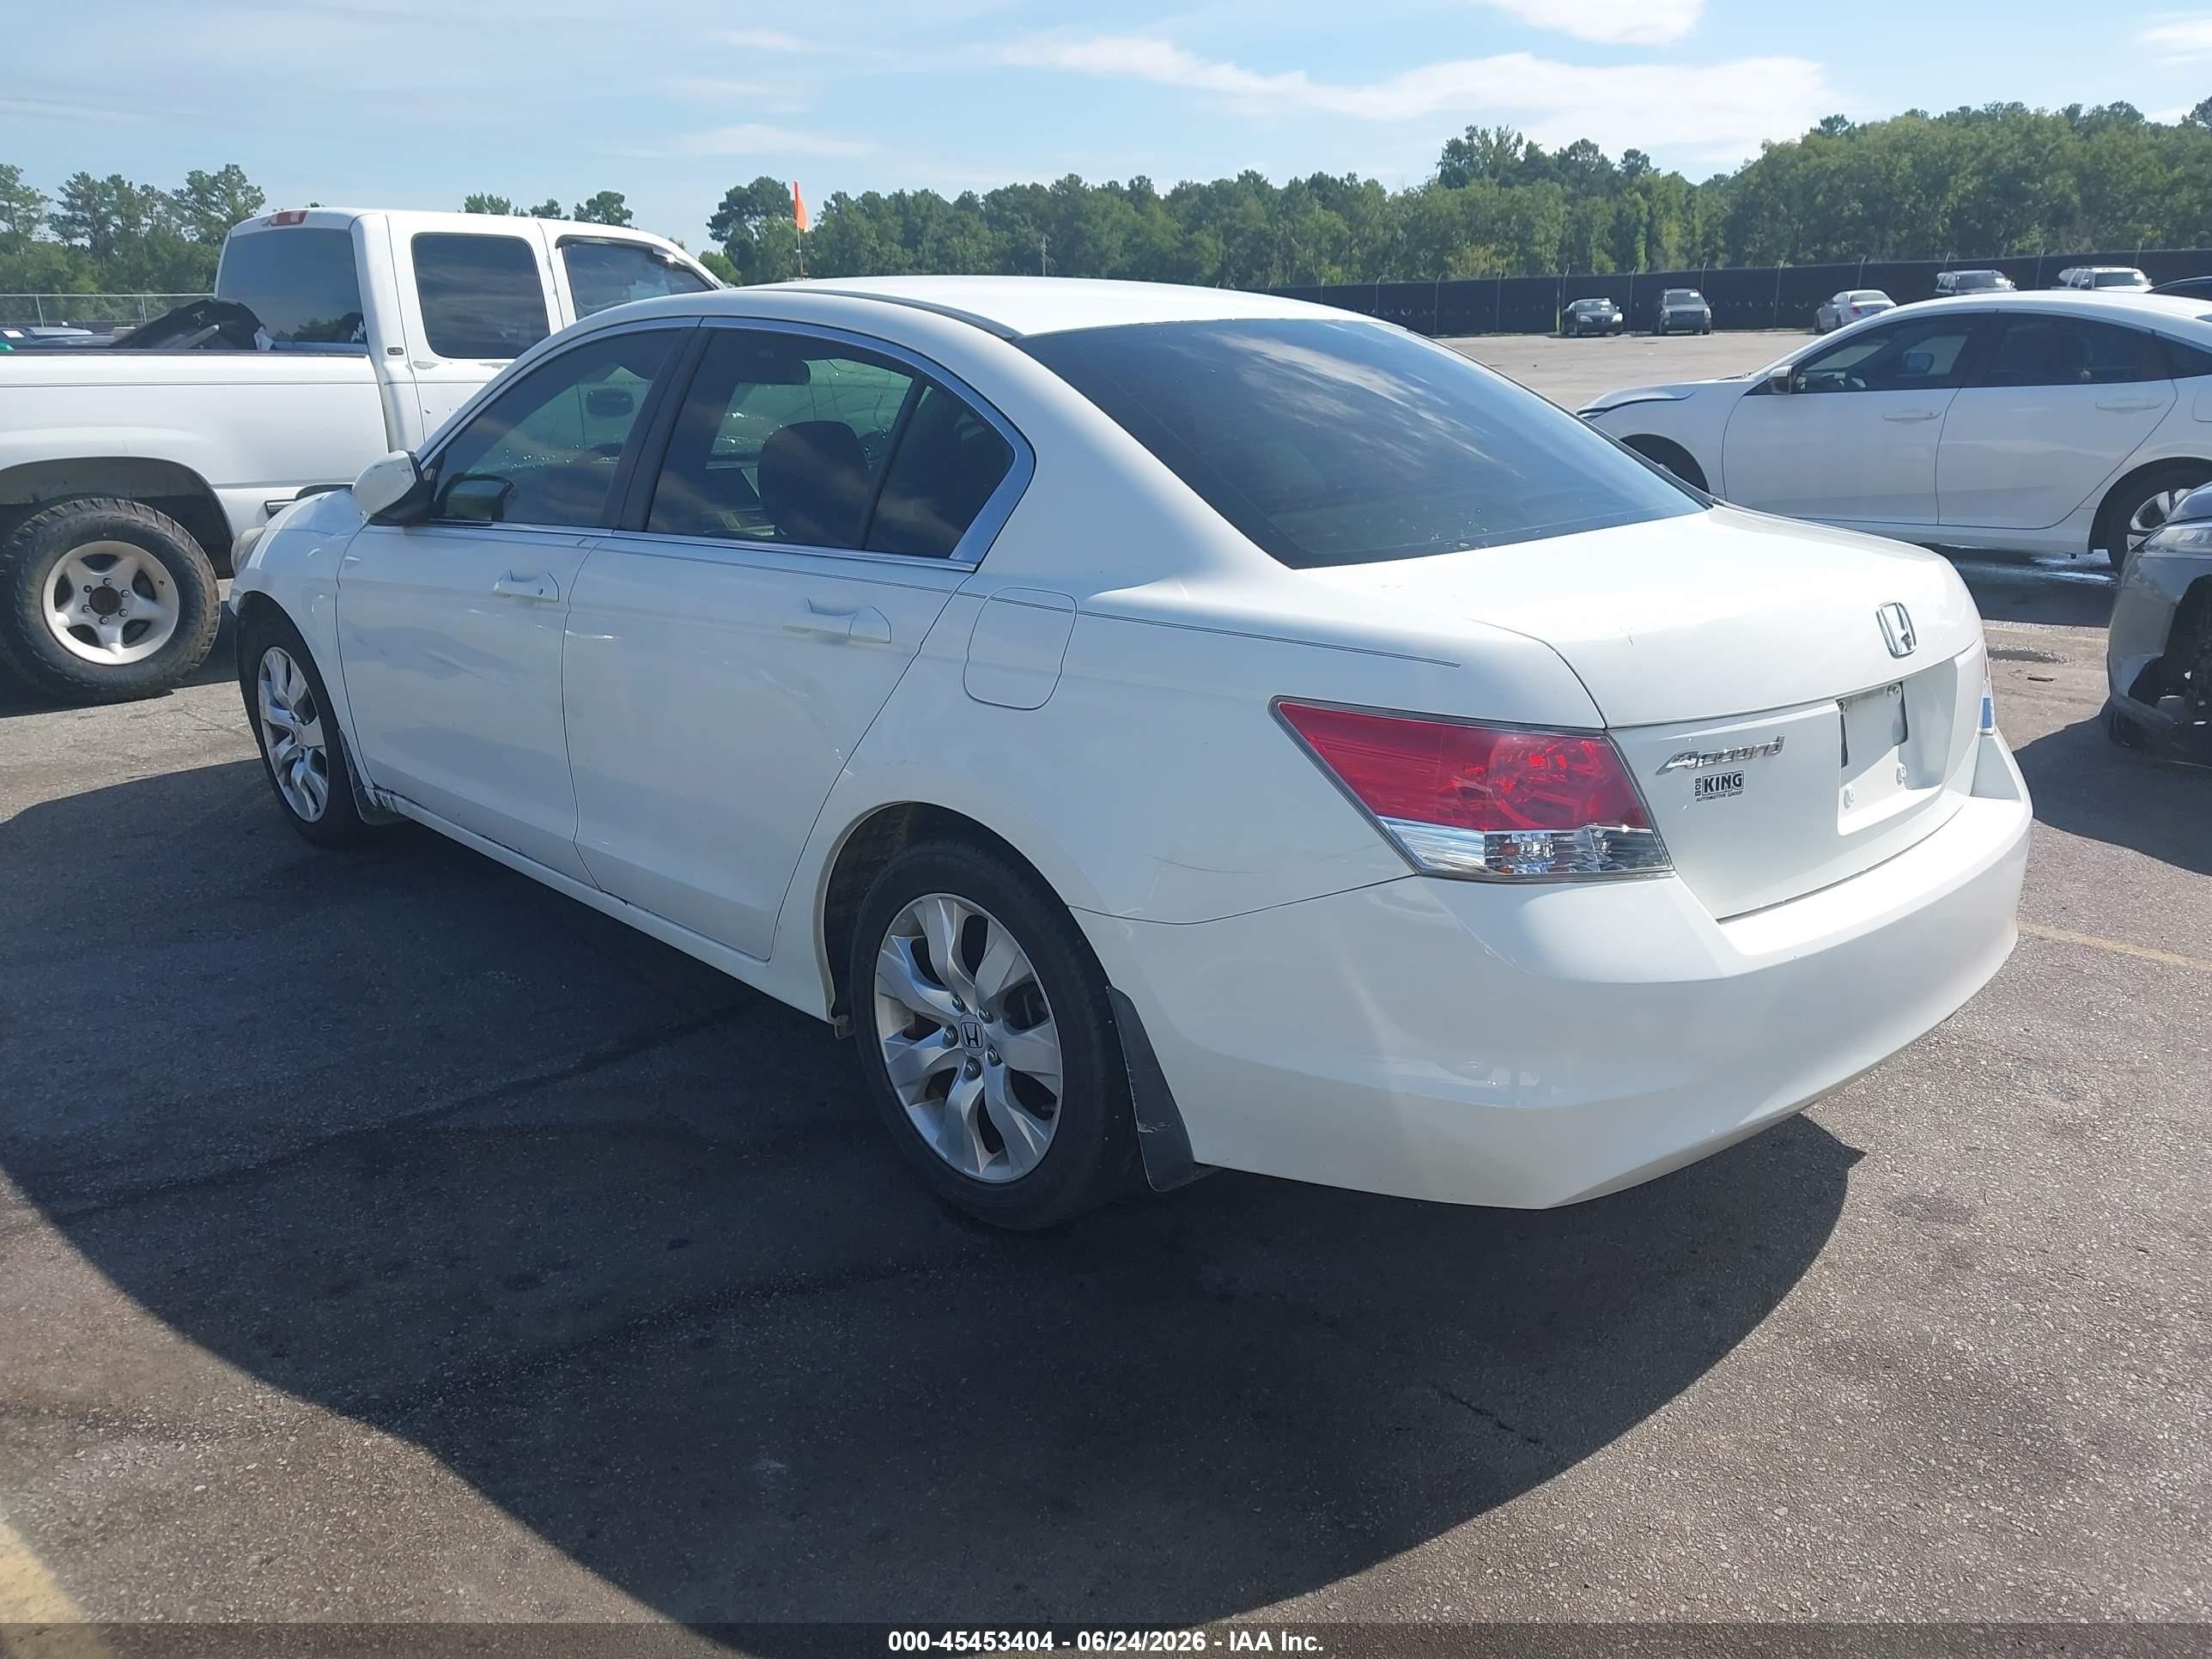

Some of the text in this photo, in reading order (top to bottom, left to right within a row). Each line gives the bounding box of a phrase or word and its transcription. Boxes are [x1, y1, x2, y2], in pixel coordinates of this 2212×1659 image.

[1656, 735, 1785, 775] Accord
[1704, 773, 1743, 793] KING
[1696, 793, 1726, 802] AUTOMOTIVE
